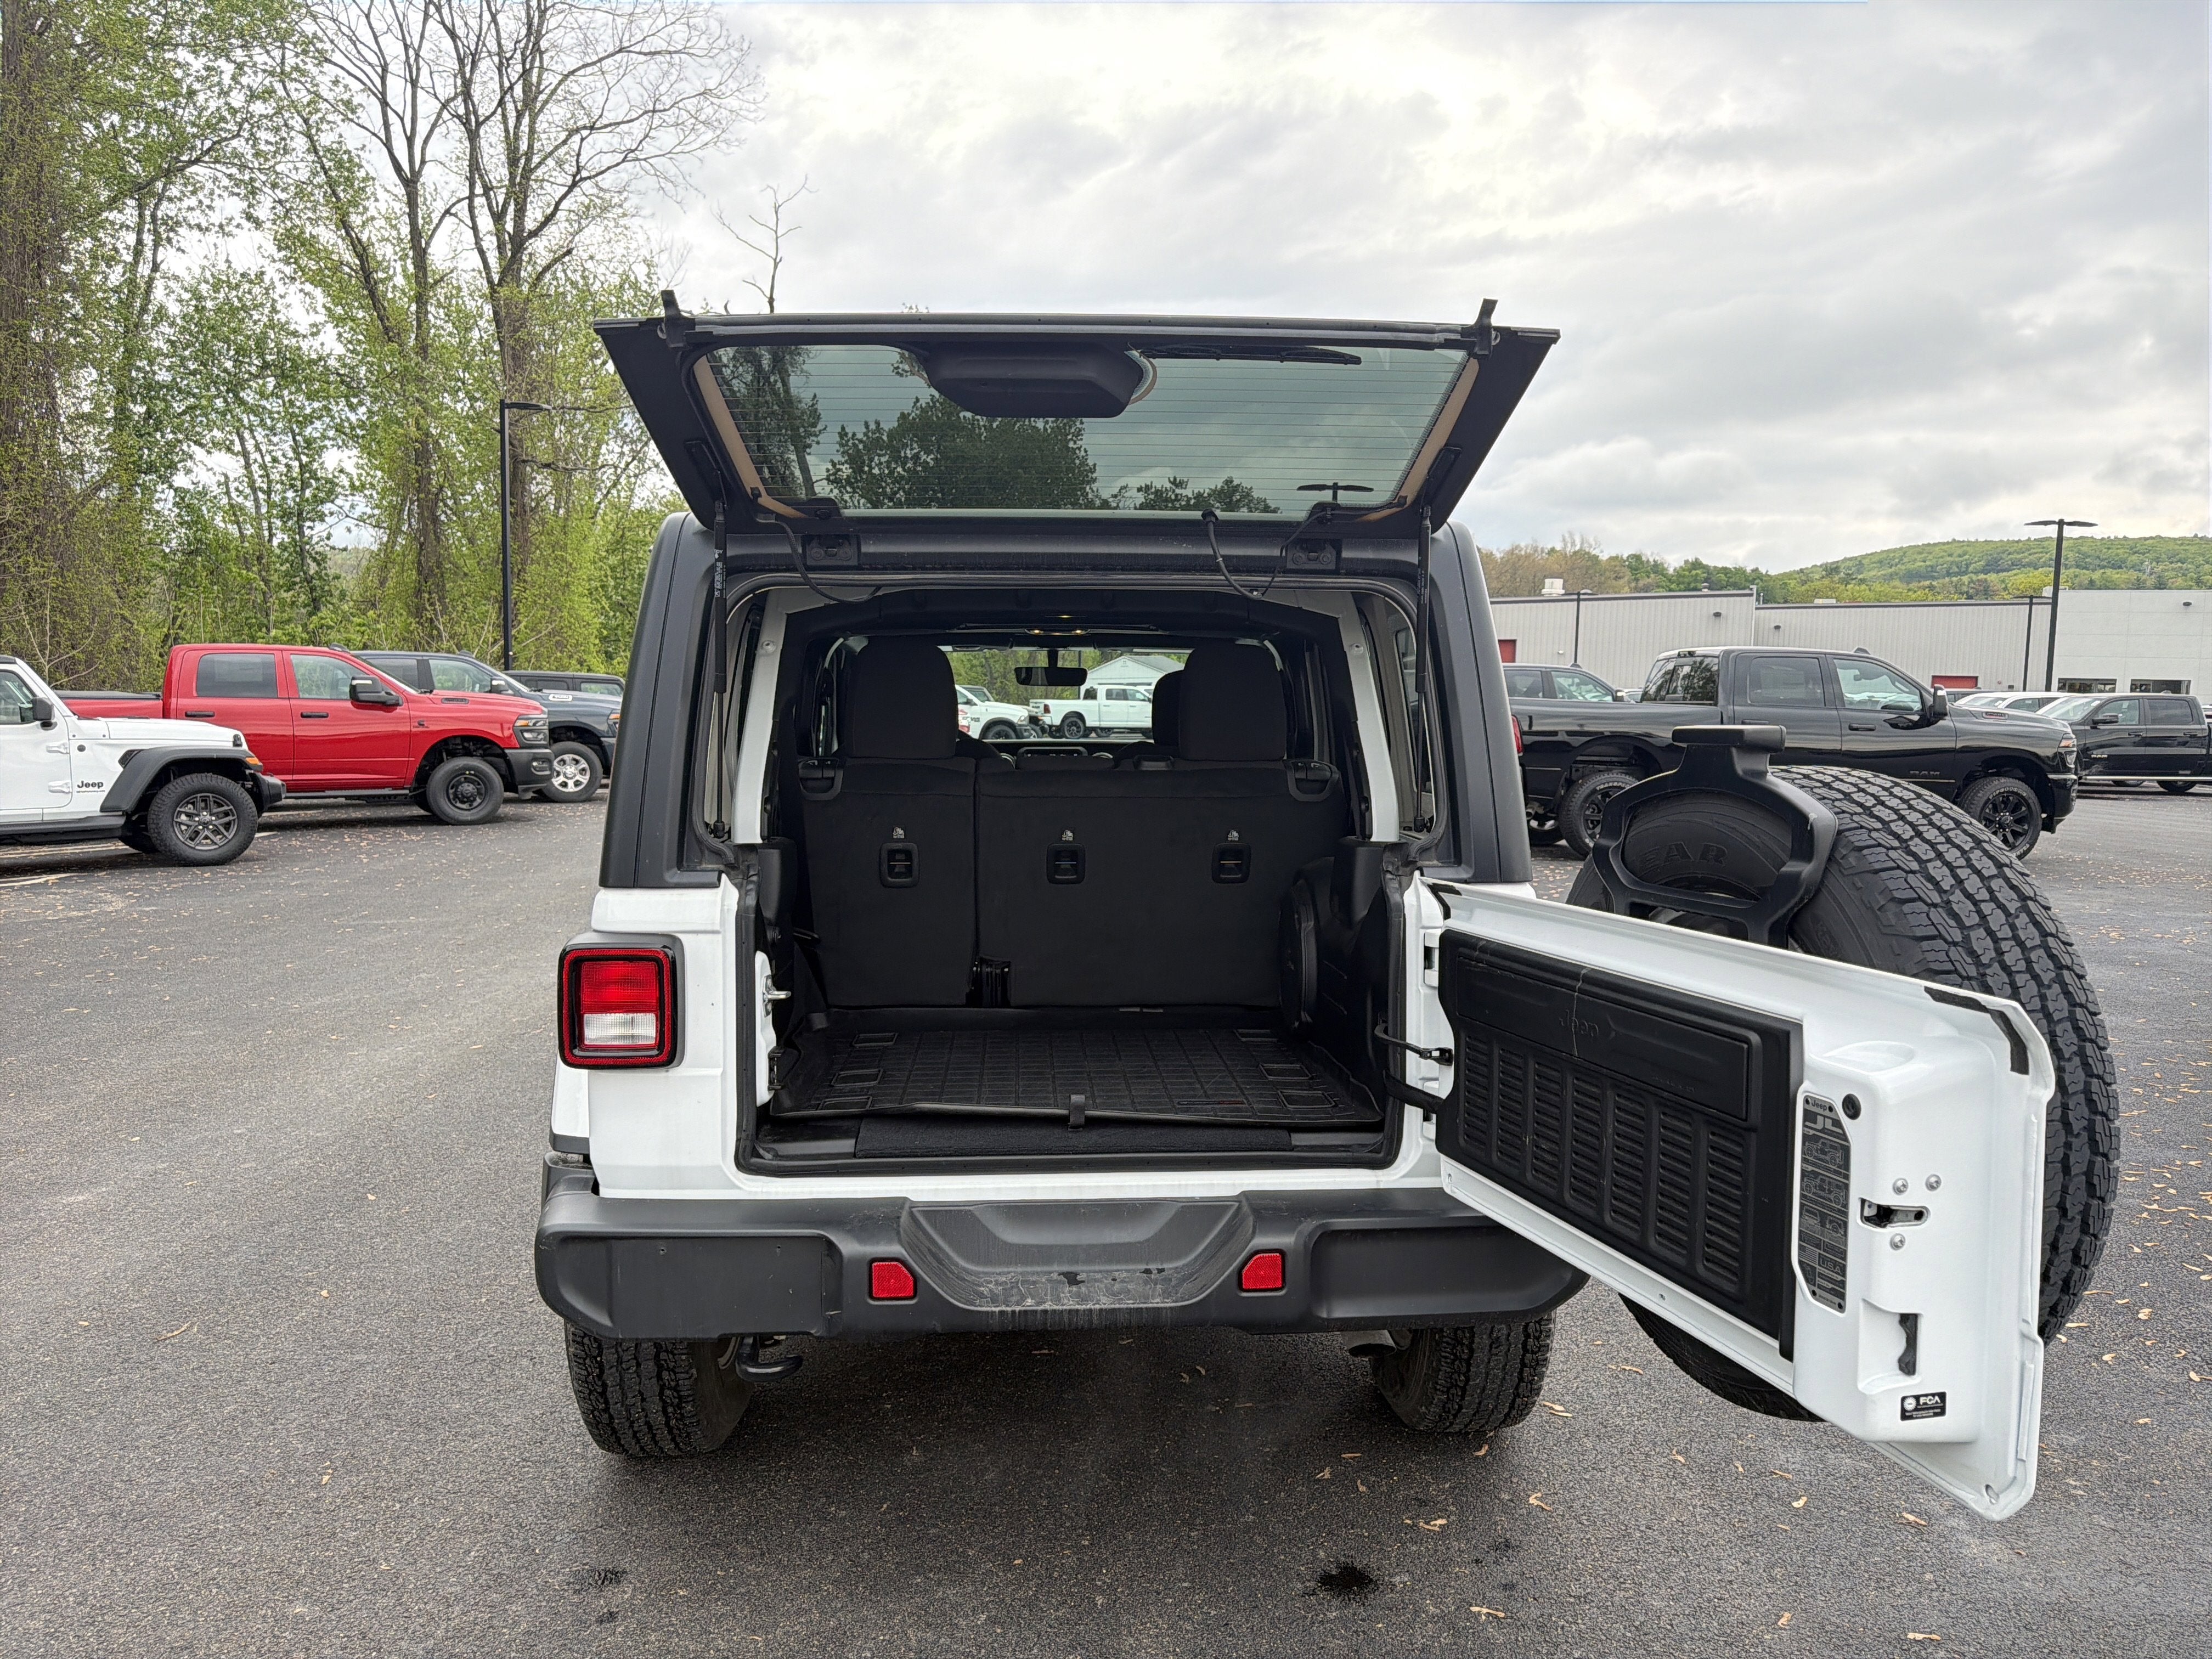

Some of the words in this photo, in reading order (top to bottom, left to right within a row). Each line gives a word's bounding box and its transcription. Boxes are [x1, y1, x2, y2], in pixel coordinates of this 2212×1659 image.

[77, 780, 104, 789] Jeep
[1559, 1009, 1599, 1039] Jeep
[1811, 1099, 1827, 1111] Jeep
[1804, 1114, 1844, 1135] JL
[1919, 1395, 1941, 1405] FCA
